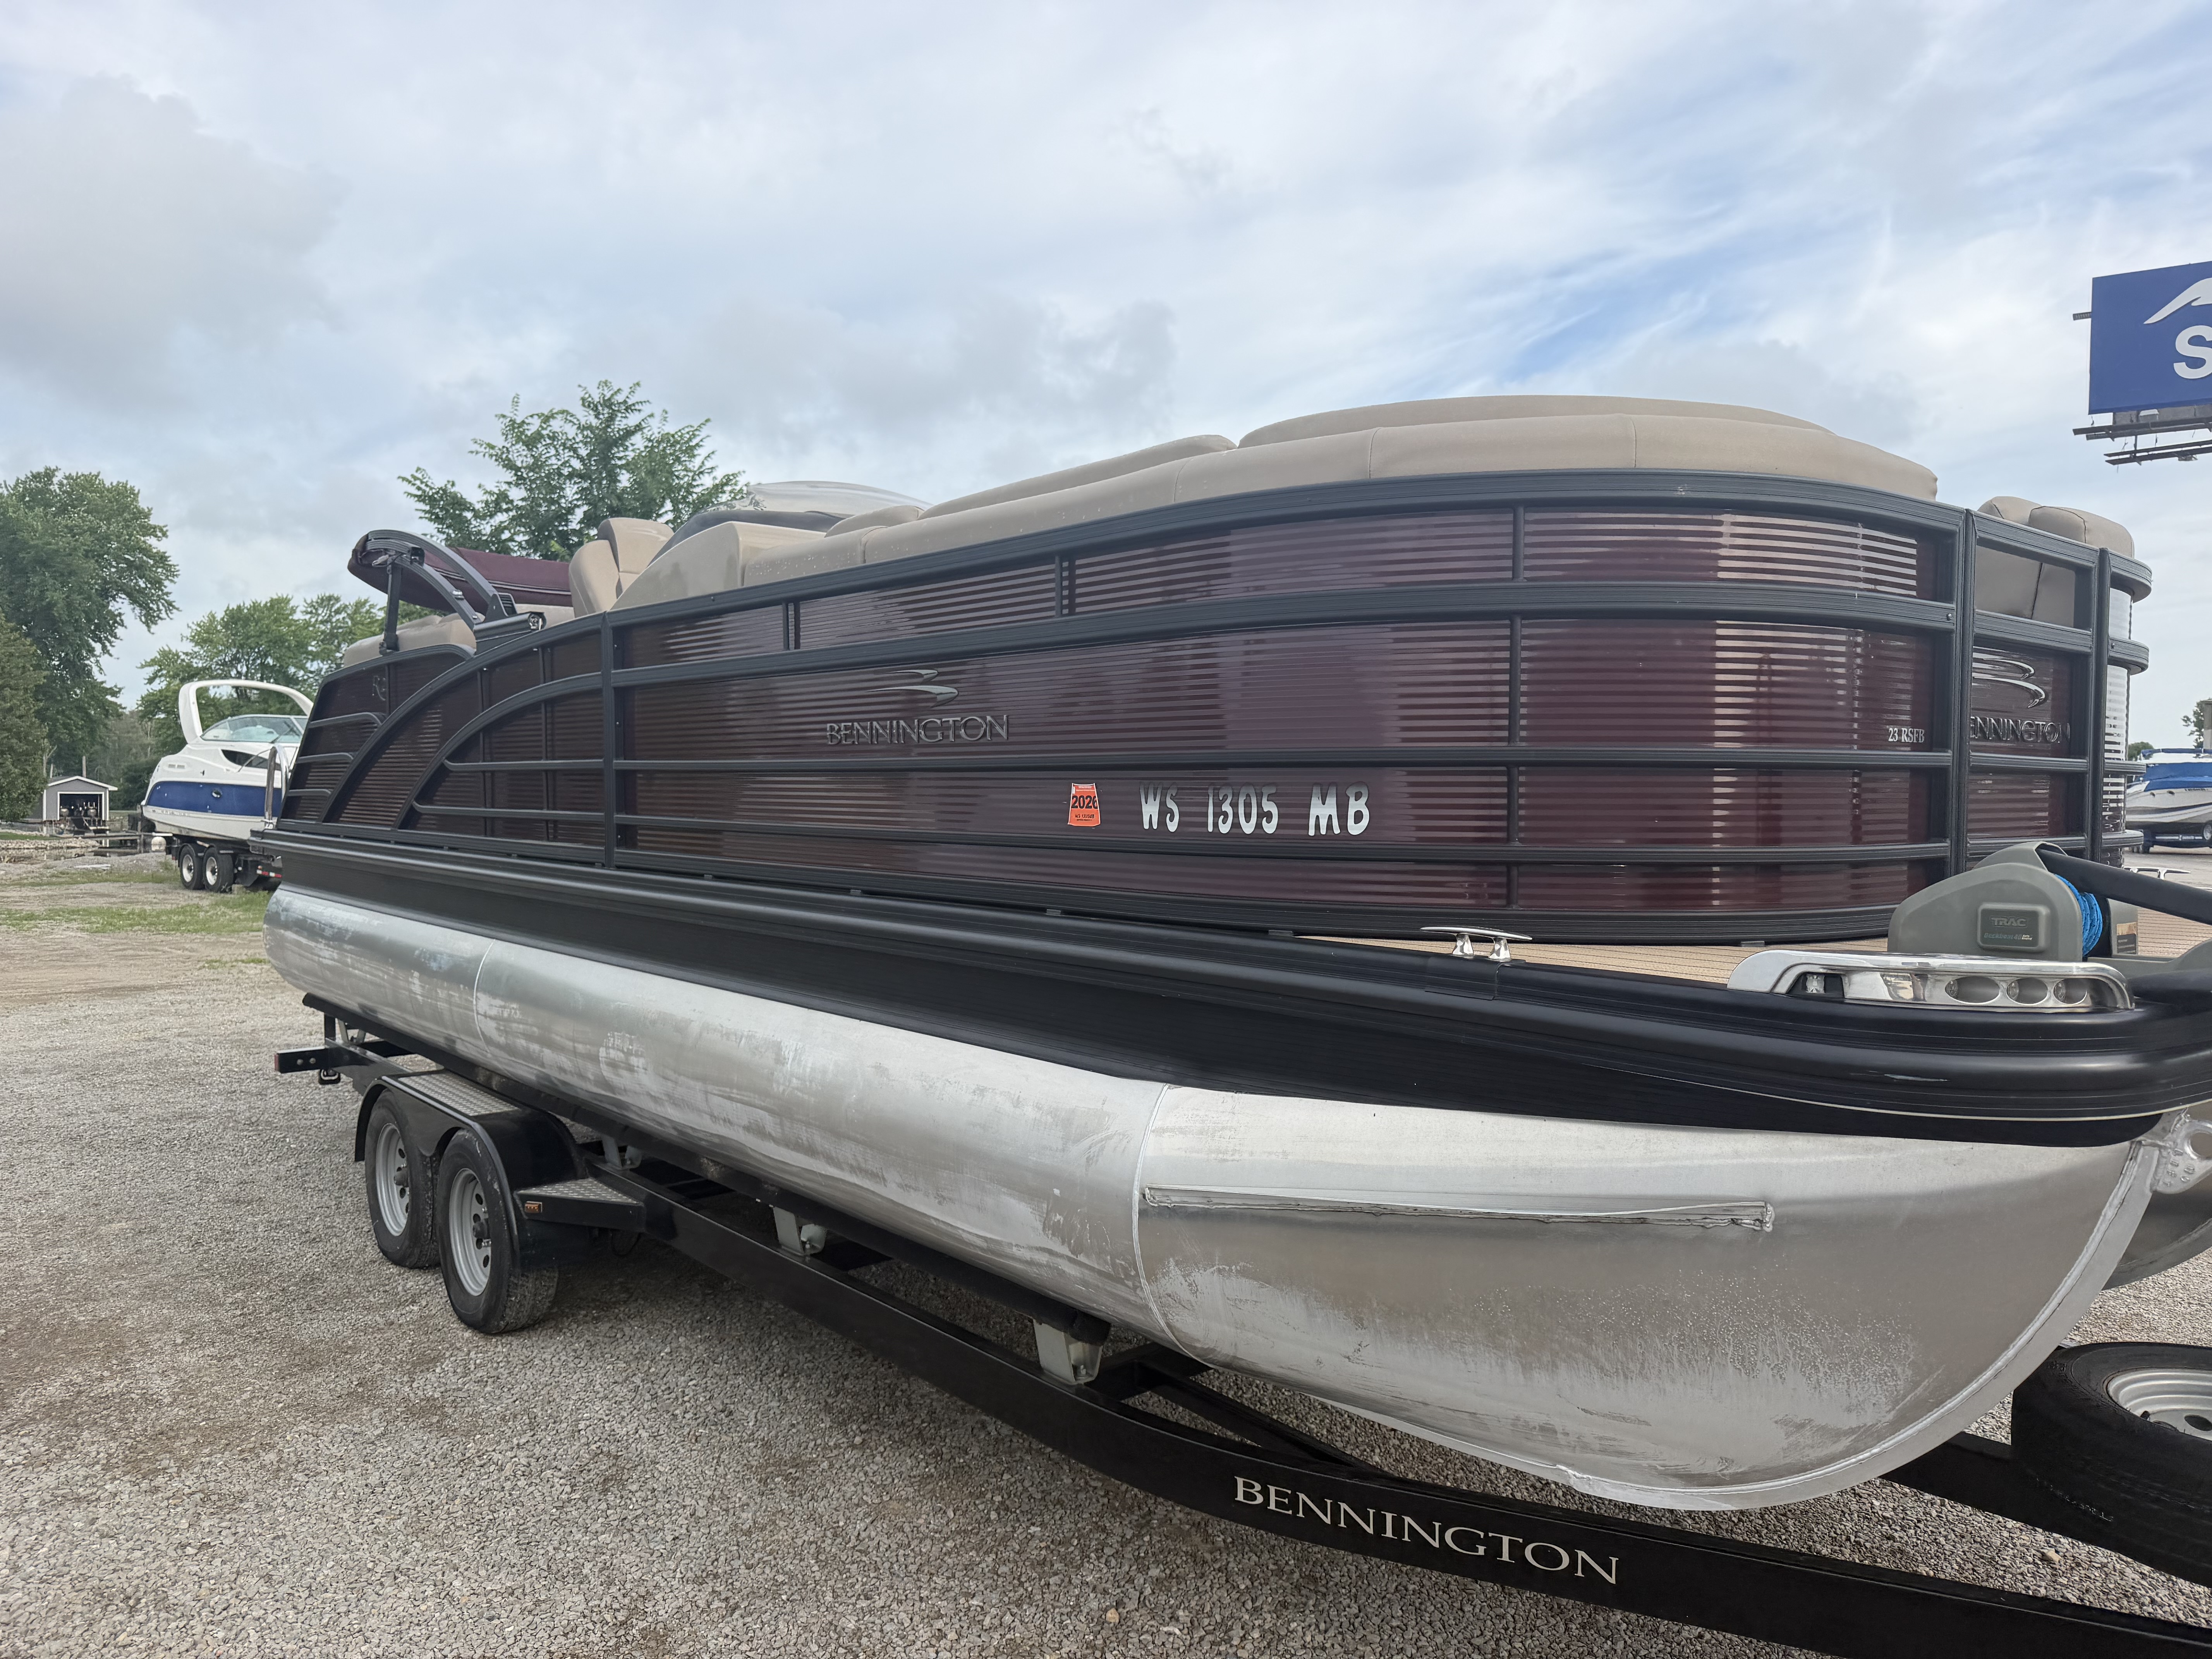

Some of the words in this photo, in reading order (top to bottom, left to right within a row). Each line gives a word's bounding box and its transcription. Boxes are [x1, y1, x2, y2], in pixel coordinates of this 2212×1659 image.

[826, 714, 1009, 745] BENNINGTON
[1888, 728, 1898, 742] 23
[1901, 728, 1925, 743] RSFB
[1970, 716, 2070, 743] ENNINGTON
[1071, 795, 1098, 809] 2026
[1139, 783, 1180, 832] WS
[1207, 782, 1278, 834] 1305
[1309, 781, 1370, 836] MB
[1990, 916, 2027, 927] TRAC
[1234, 1475, 1619, 1585] BENNINGTON
